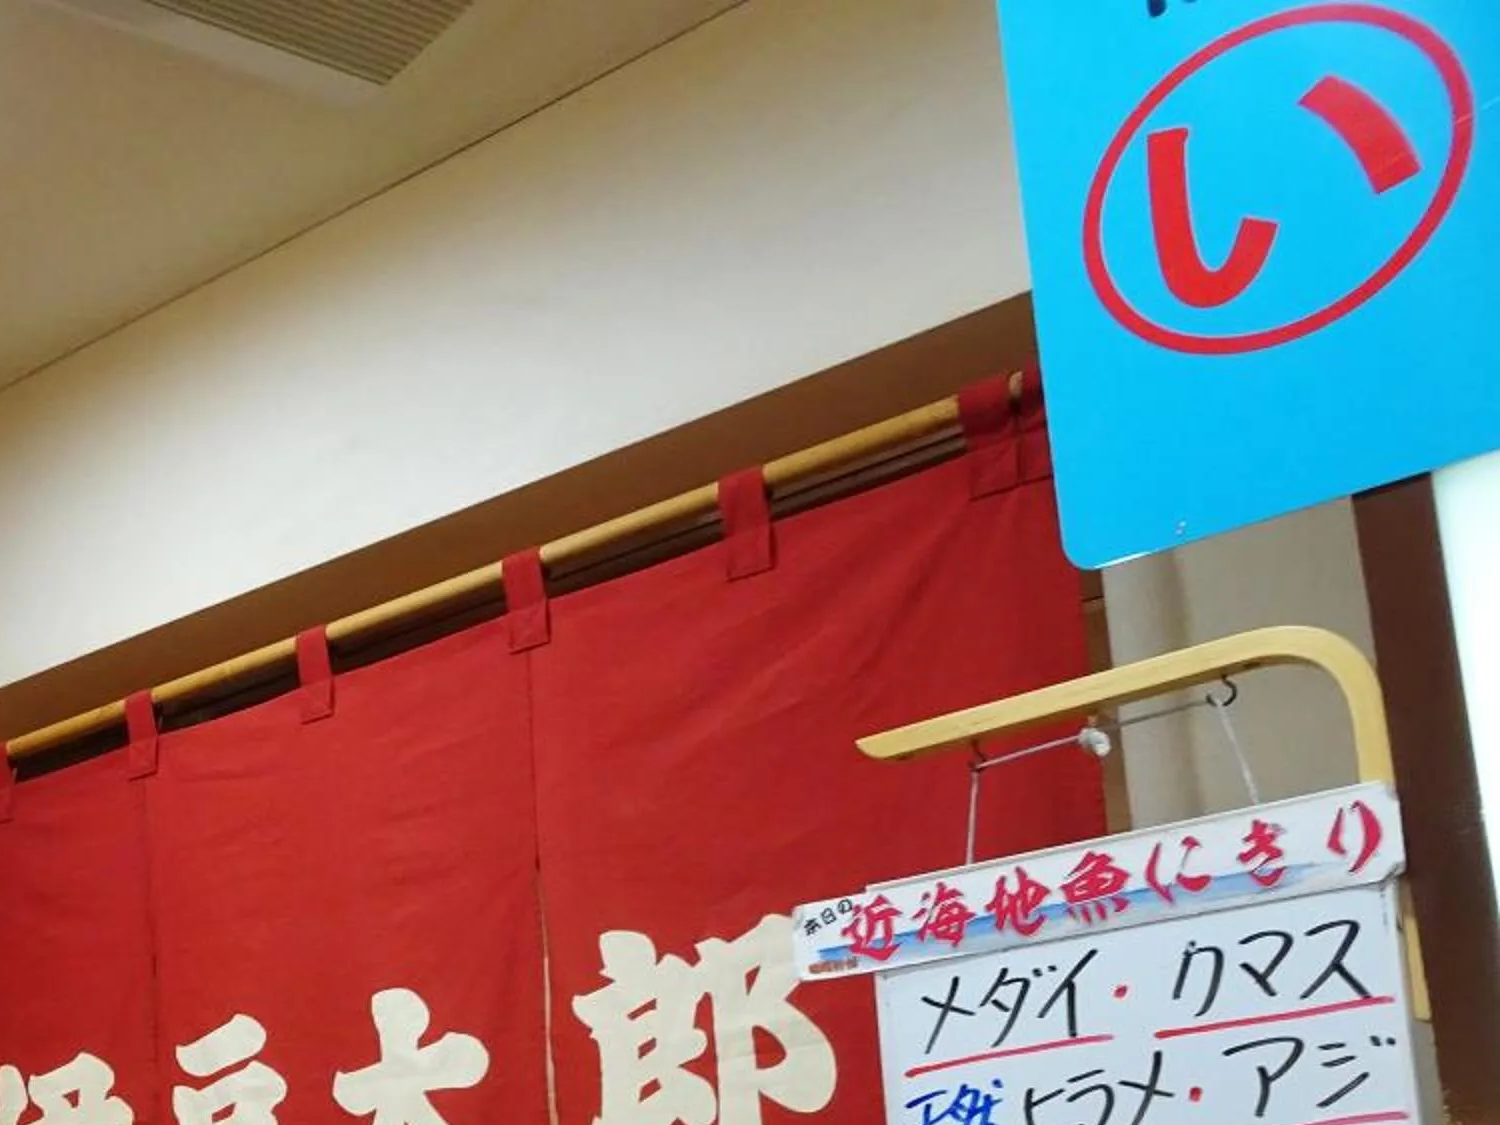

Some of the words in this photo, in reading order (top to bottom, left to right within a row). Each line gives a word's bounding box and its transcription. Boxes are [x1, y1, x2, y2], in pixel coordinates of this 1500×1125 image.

[1146, 74, 1422, 309] い
[803, 898, 854, 937] 本日の
